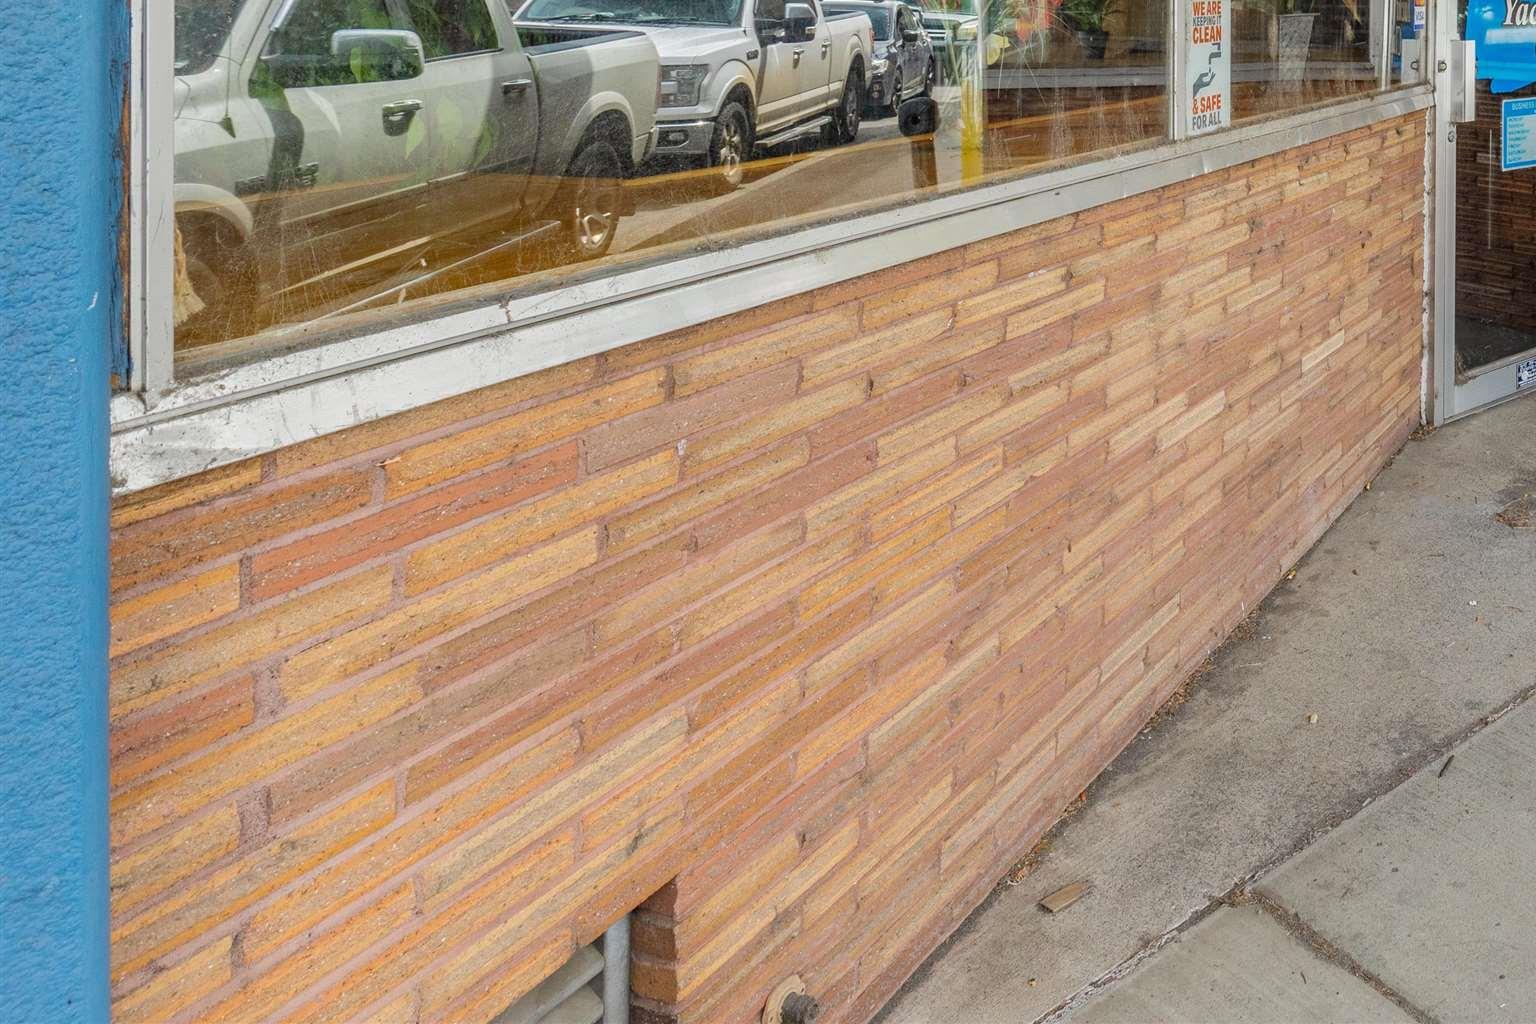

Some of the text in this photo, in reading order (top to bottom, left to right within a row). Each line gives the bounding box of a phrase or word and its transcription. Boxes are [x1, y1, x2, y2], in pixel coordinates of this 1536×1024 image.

[1192, 0, 1222, 16] WE ARE
[1192, 17, 1215, 27] KEEPING
[1192, 25, 1222, 44] CLEAN
[1192, 94, 1222, 115] & SAFE
[1192, 113, 1222, 131] FOR ALL
